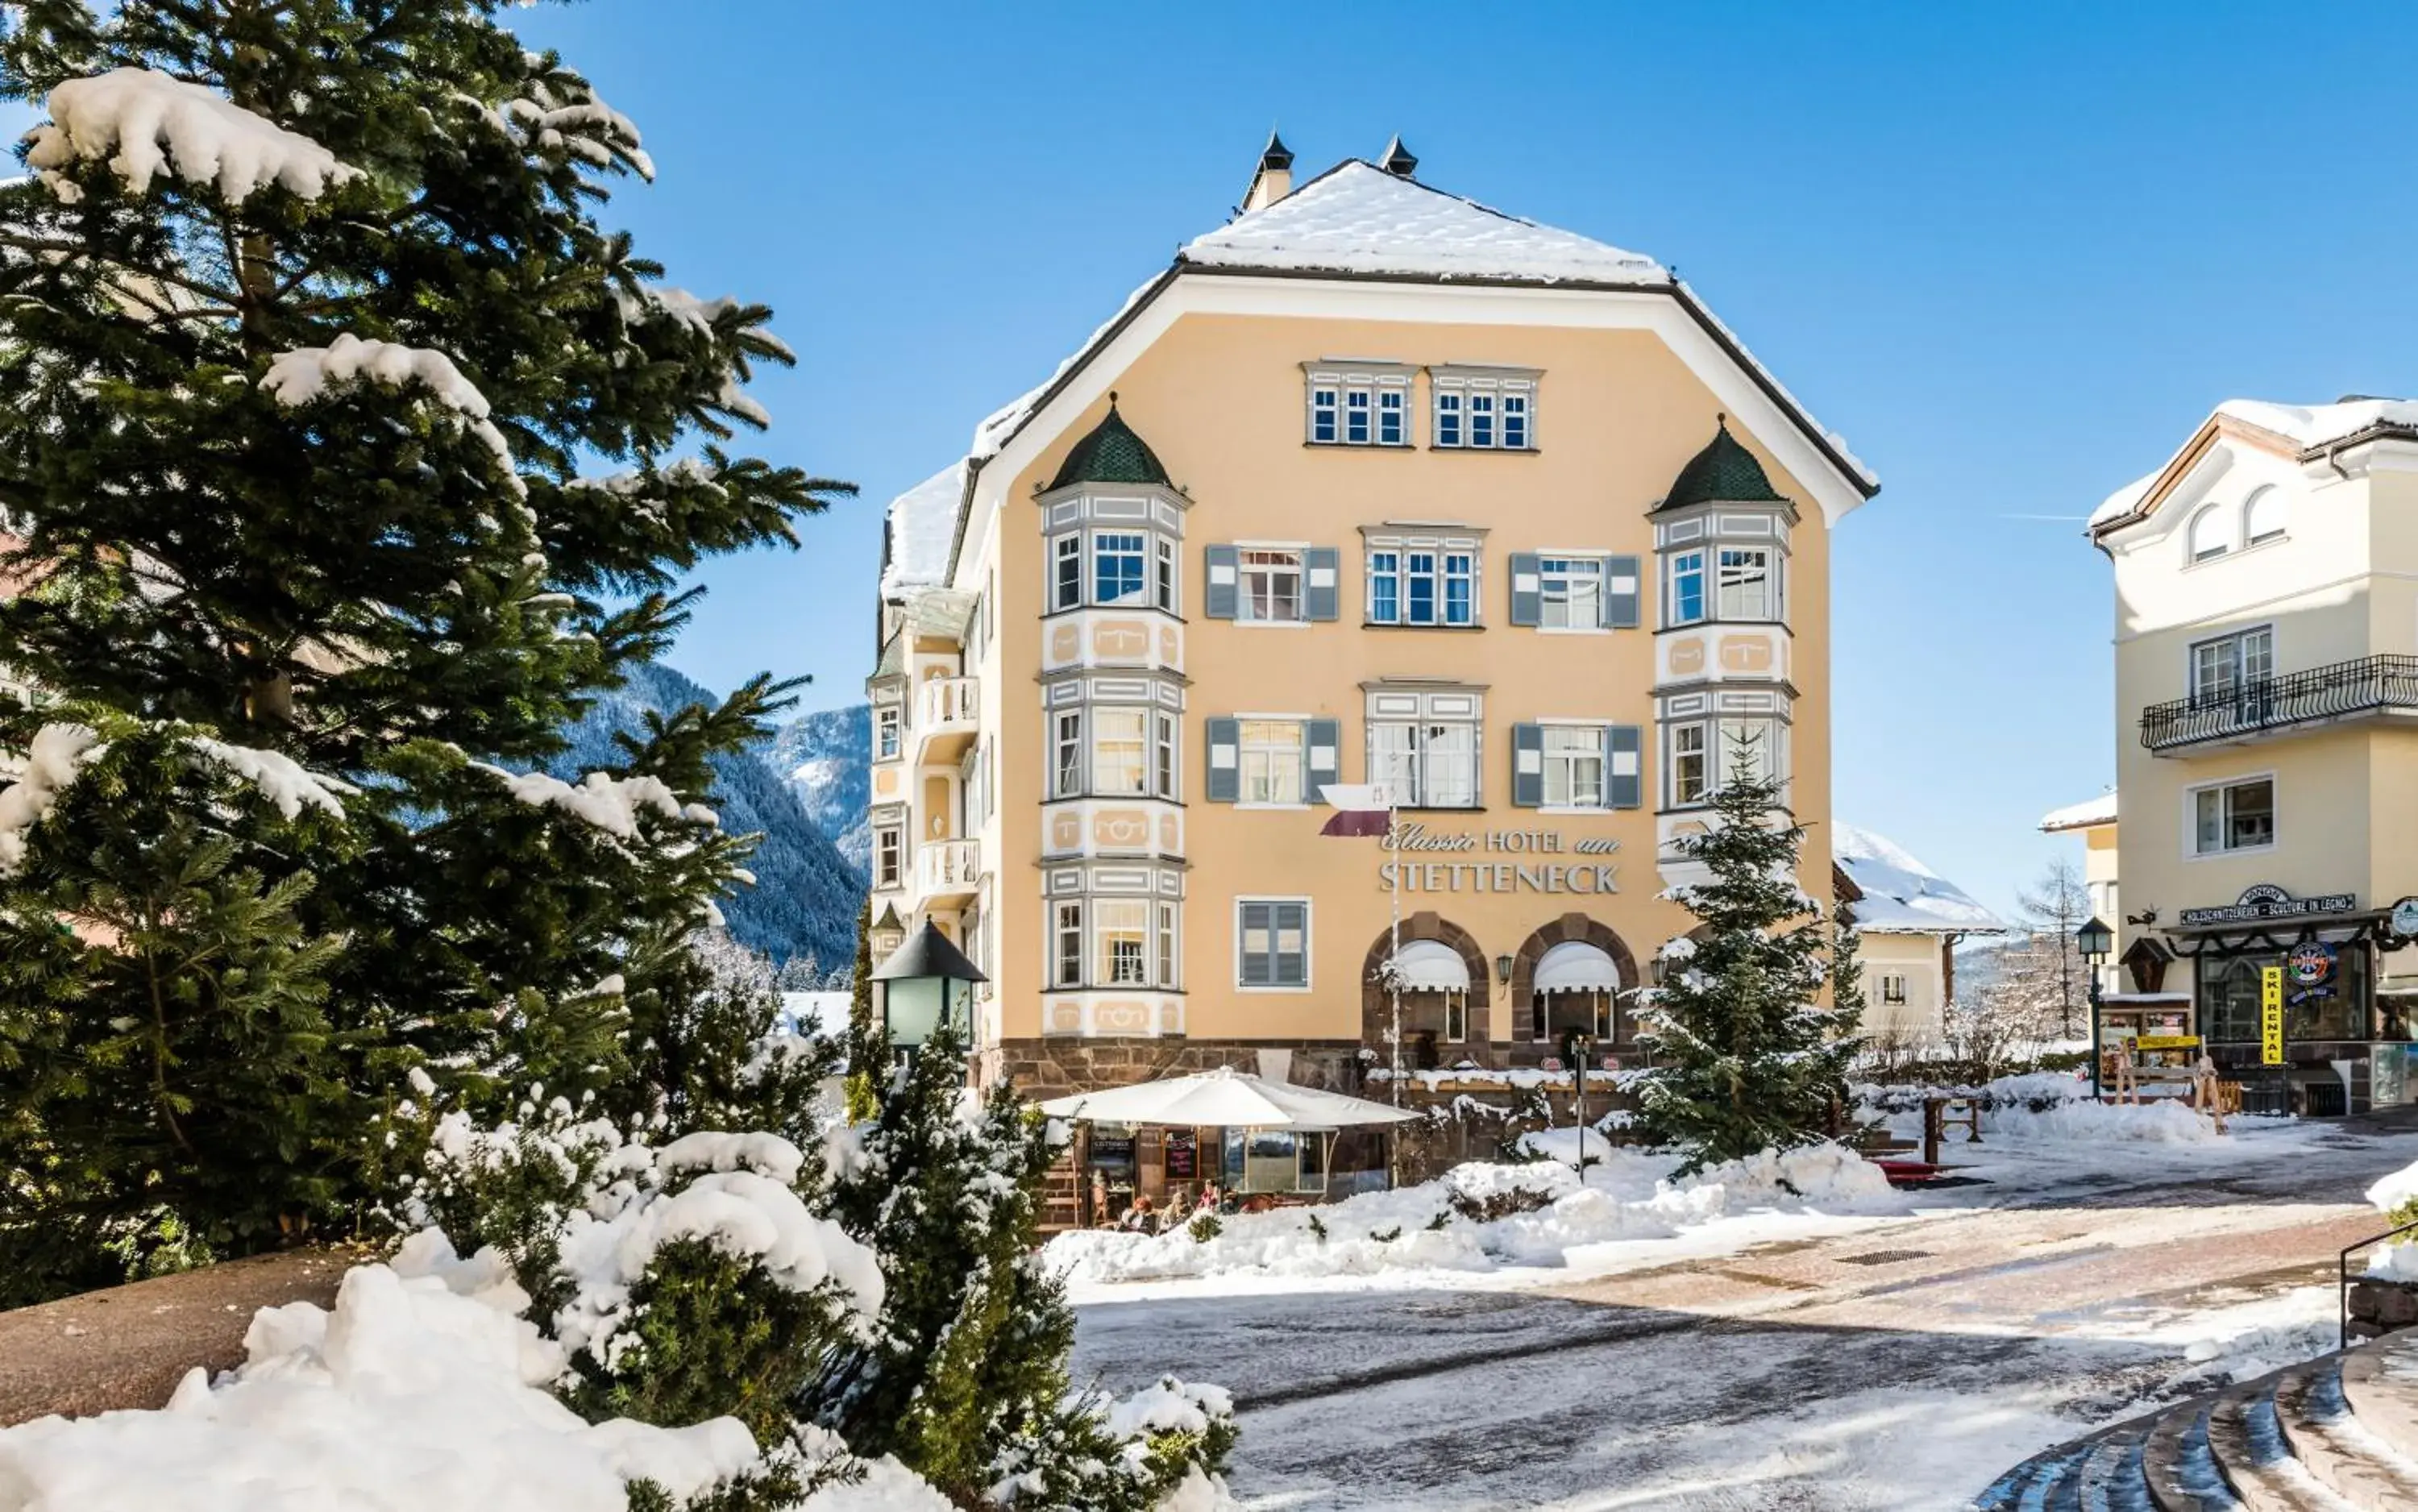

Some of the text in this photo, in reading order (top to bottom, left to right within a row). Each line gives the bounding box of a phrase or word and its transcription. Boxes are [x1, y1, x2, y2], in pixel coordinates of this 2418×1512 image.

[1380, 823, 1477, 852] Classic
[1485, 830, 1564, 853] HOTEL
[1380, 862, 1621, 895] STETTENECK
[2309, 899, 2319, 911] IN
[2321, 897, 2346, 910] LEGNO
[2266, 971, 2279, 1061] SKI RENTAL
